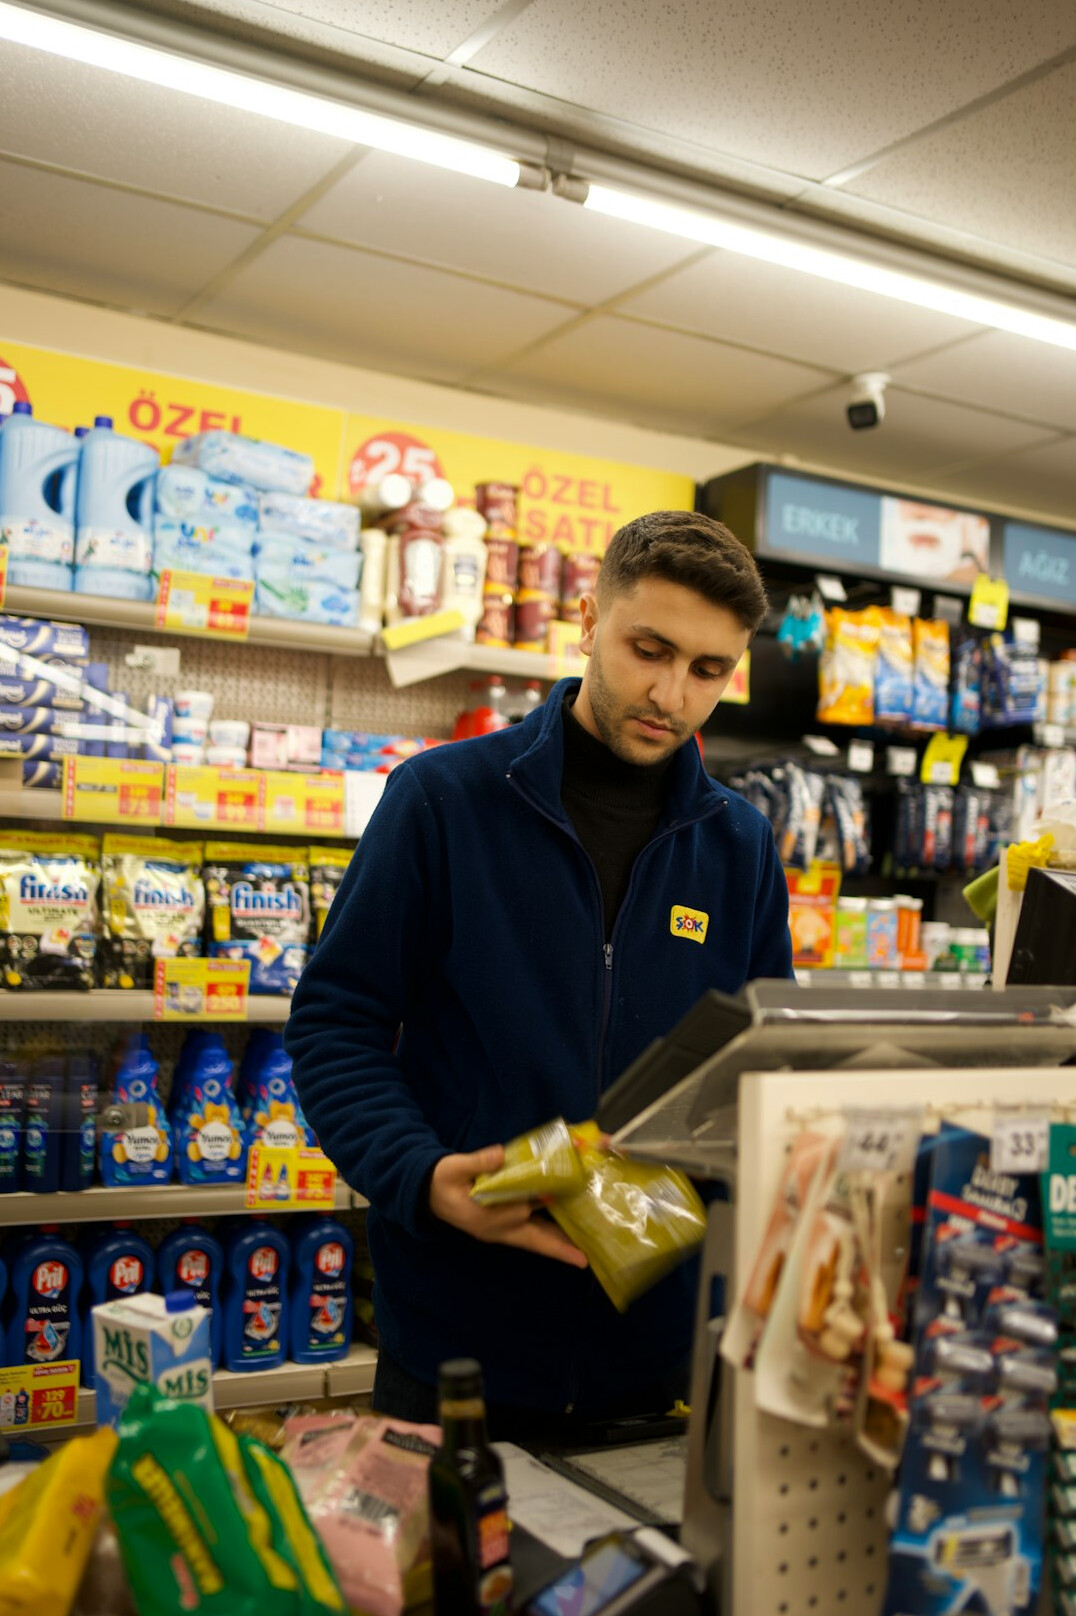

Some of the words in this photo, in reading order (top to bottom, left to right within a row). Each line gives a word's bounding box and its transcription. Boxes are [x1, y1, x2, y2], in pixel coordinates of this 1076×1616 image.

[522, 463, 620, 514] ÖZEL
[782, 504, 861, 546] ERKEK
[20, 875, 87, 900] finish
[235, 883, 300, 909] finish
[1011, 1132, 1035, 1156] 33
[36, 1265, 65, 1291] Pril
[113, 1260, 141, 1286] Pril
[42, 1401, 63, 1420] 70
